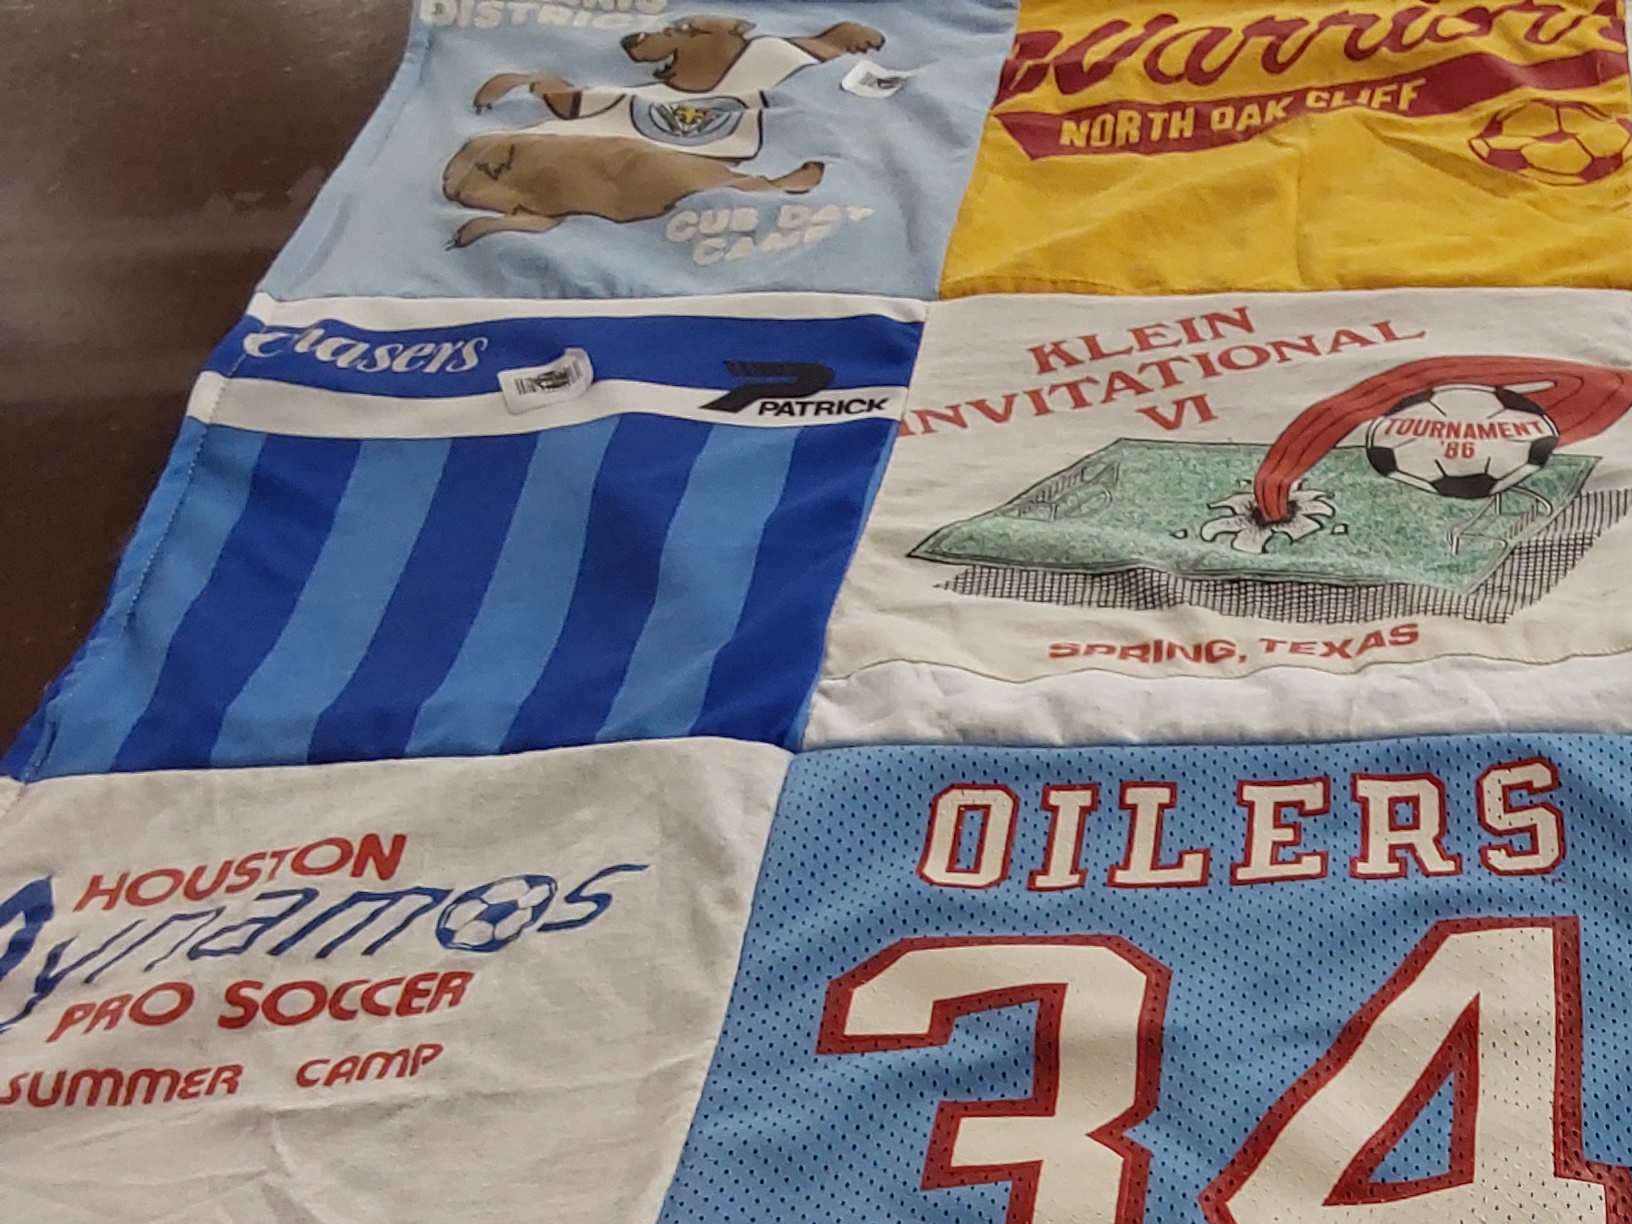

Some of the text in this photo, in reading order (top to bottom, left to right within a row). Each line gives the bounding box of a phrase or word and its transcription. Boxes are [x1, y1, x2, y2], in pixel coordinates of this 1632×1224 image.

[1058, 78, 1426, 148] NORTH OAK CLIFF
[1028, 306, 1258, 374] KLEIN
[757, 396, 890, 418] PATRICK
[896, 320, 1428, 438] INVITATIONAL
[1136, 394, 1220, 431] VI
[1383, 416, 1546, 440] TOURNAMENT
[1440, 439, 1475, 459] '86
[1048, 622, 1420, 664] SPRING, TEXAS
[918, 756, 1564, 890] OILERS
[73, 833, 407, 912] HOUSTON
[46, 971, 474, 1043] PRO SOCCER
[0, 1043, 443, 1108] SUMMER CAMP
